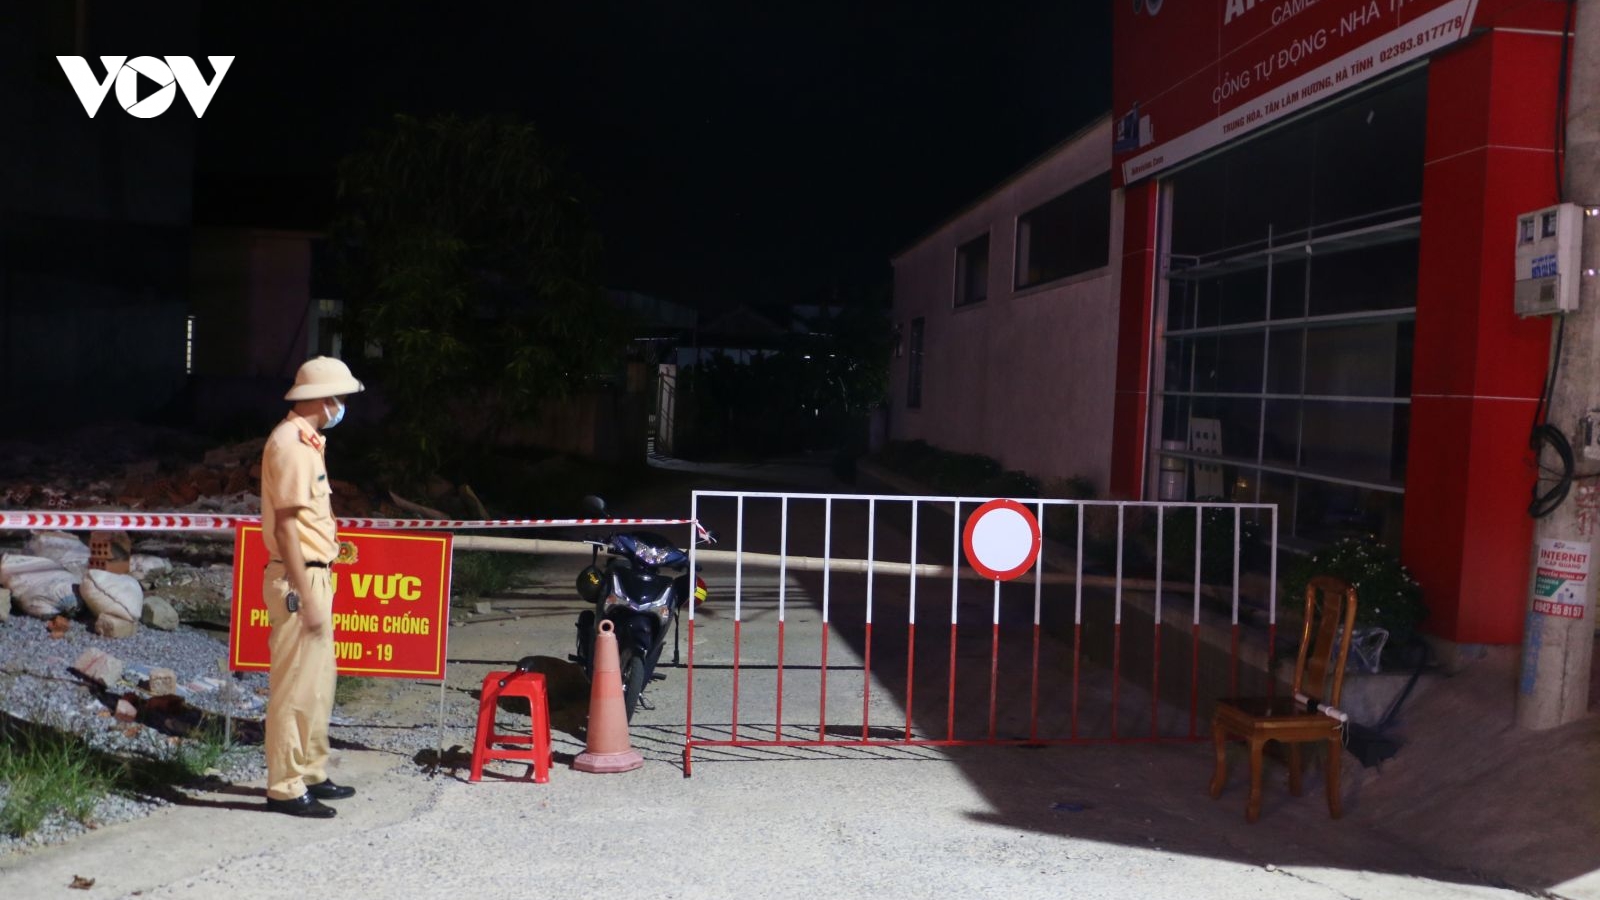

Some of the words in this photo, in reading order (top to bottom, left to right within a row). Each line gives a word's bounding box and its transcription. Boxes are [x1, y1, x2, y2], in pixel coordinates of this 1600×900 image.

[1254, 54, 1275, 81] TỰ
[1278, 28, 1328, 69] ĐỘNG
[1223, 116, 1246, 134] TRUNG
[1335, 66, 1349, 83] HÀ
[1380, 15, 1463, 62] 02393.817778
[1540, 548, 1588, 563] INTERNET
[351, 573, 422, 604] VỰC
[332, 610, 379, 633] PHÒNG
[383, 610, 430, 635] CHỐNG
[334, 641, 362, 660] OVID
[376, 644, 393, 661] 19
